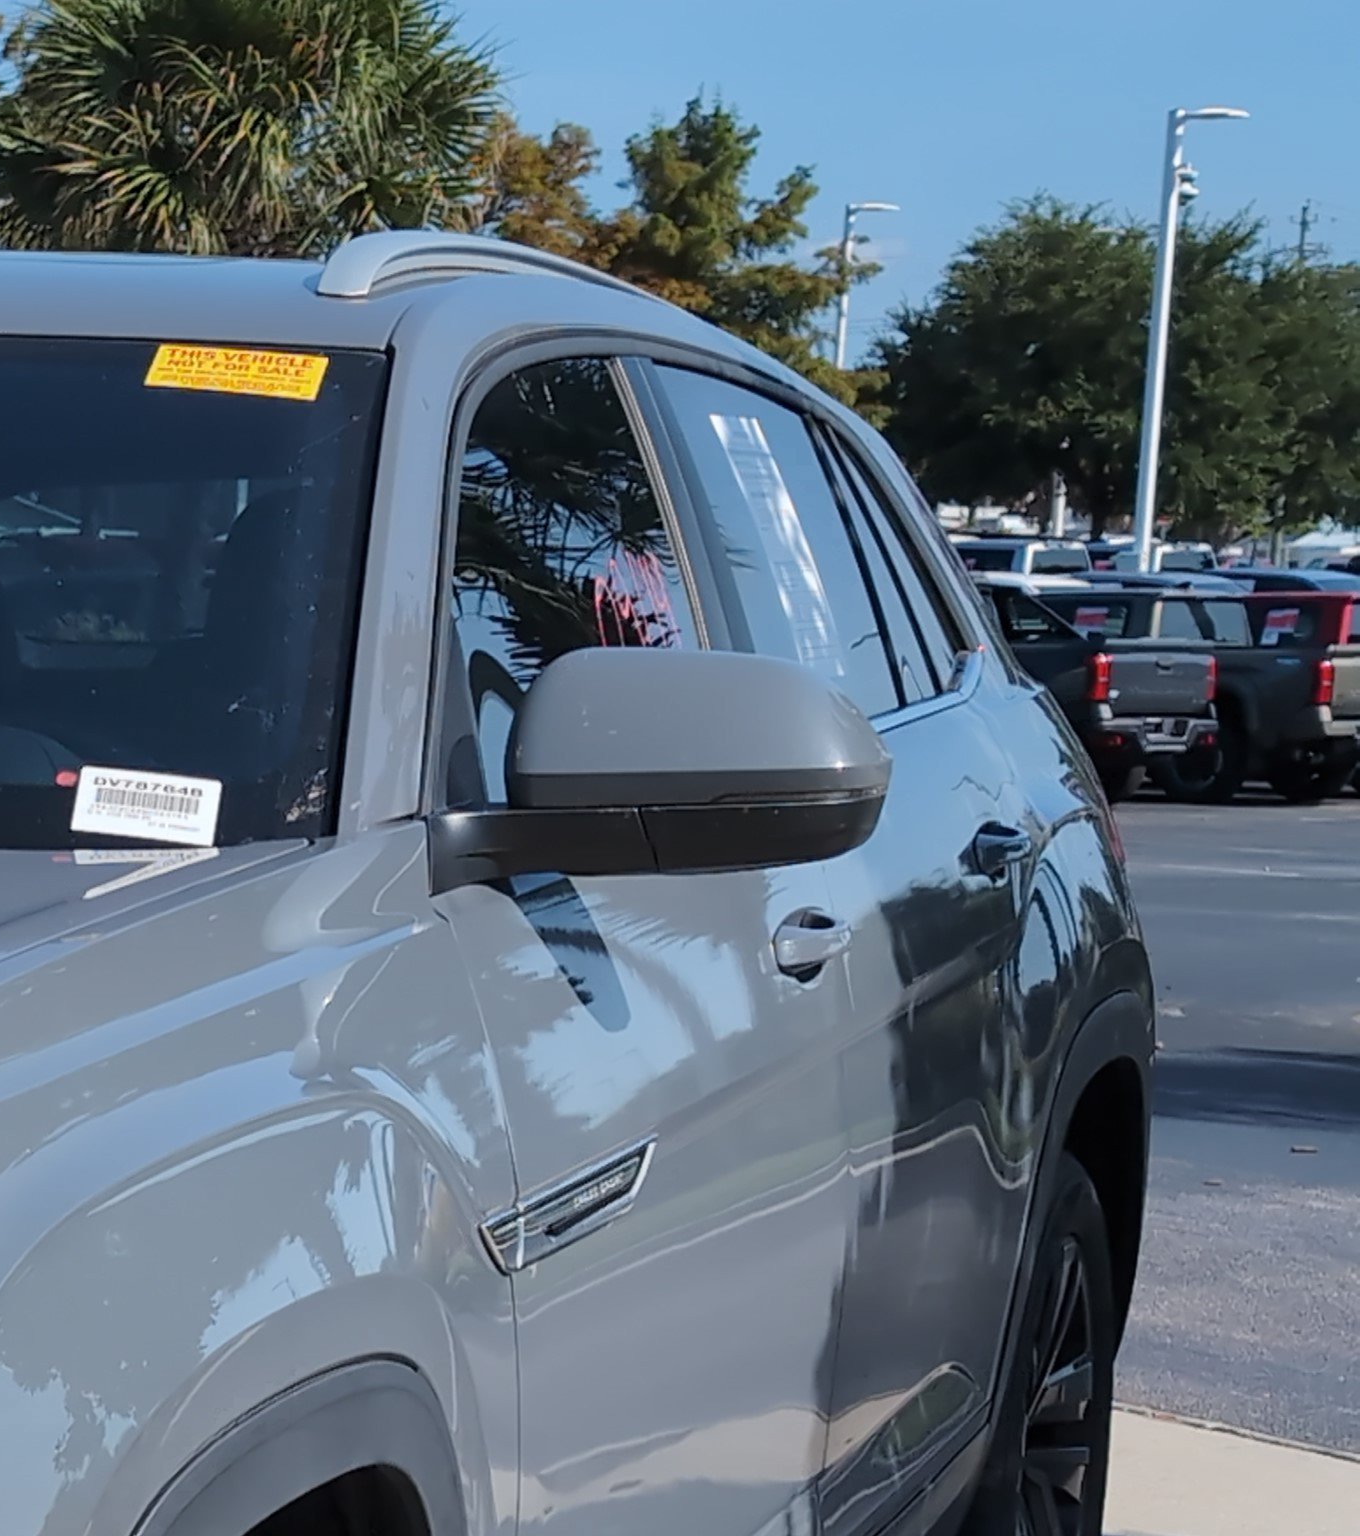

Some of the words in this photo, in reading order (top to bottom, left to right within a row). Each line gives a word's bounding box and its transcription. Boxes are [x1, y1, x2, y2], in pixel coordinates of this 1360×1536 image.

[166, 348, 217, 361] THIS
[223, 352, 314, 369] VEHICLE
[166, 360, 203, 369] NOT
[211, 361, 251, 372] FOR
[257, 366, 305, 378] SALE
